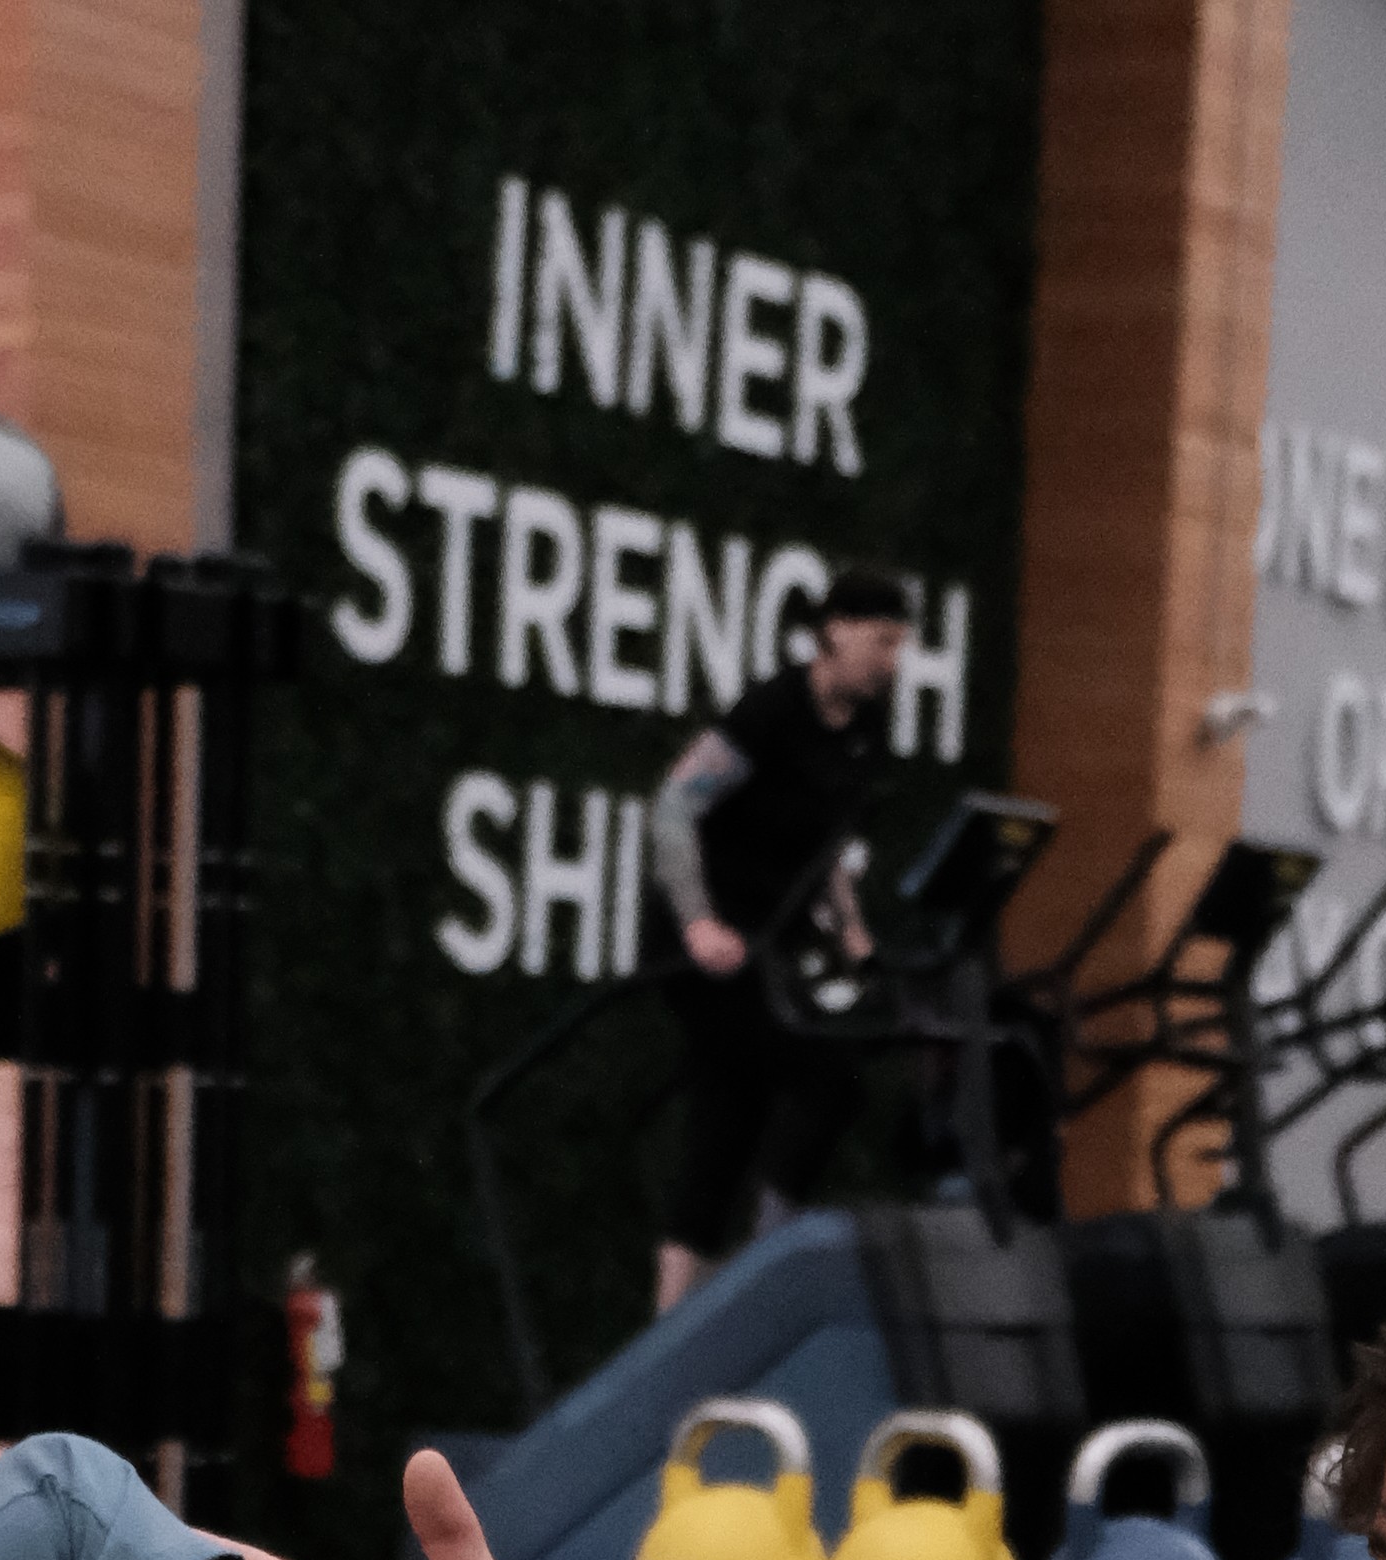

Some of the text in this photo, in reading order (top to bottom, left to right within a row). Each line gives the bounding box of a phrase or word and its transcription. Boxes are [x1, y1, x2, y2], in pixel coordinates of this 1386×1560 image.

[488, 174, 870, 477] INNER
[331, 446, 969, 763] STRENGH
[436, 770, 645, 981] SHI
